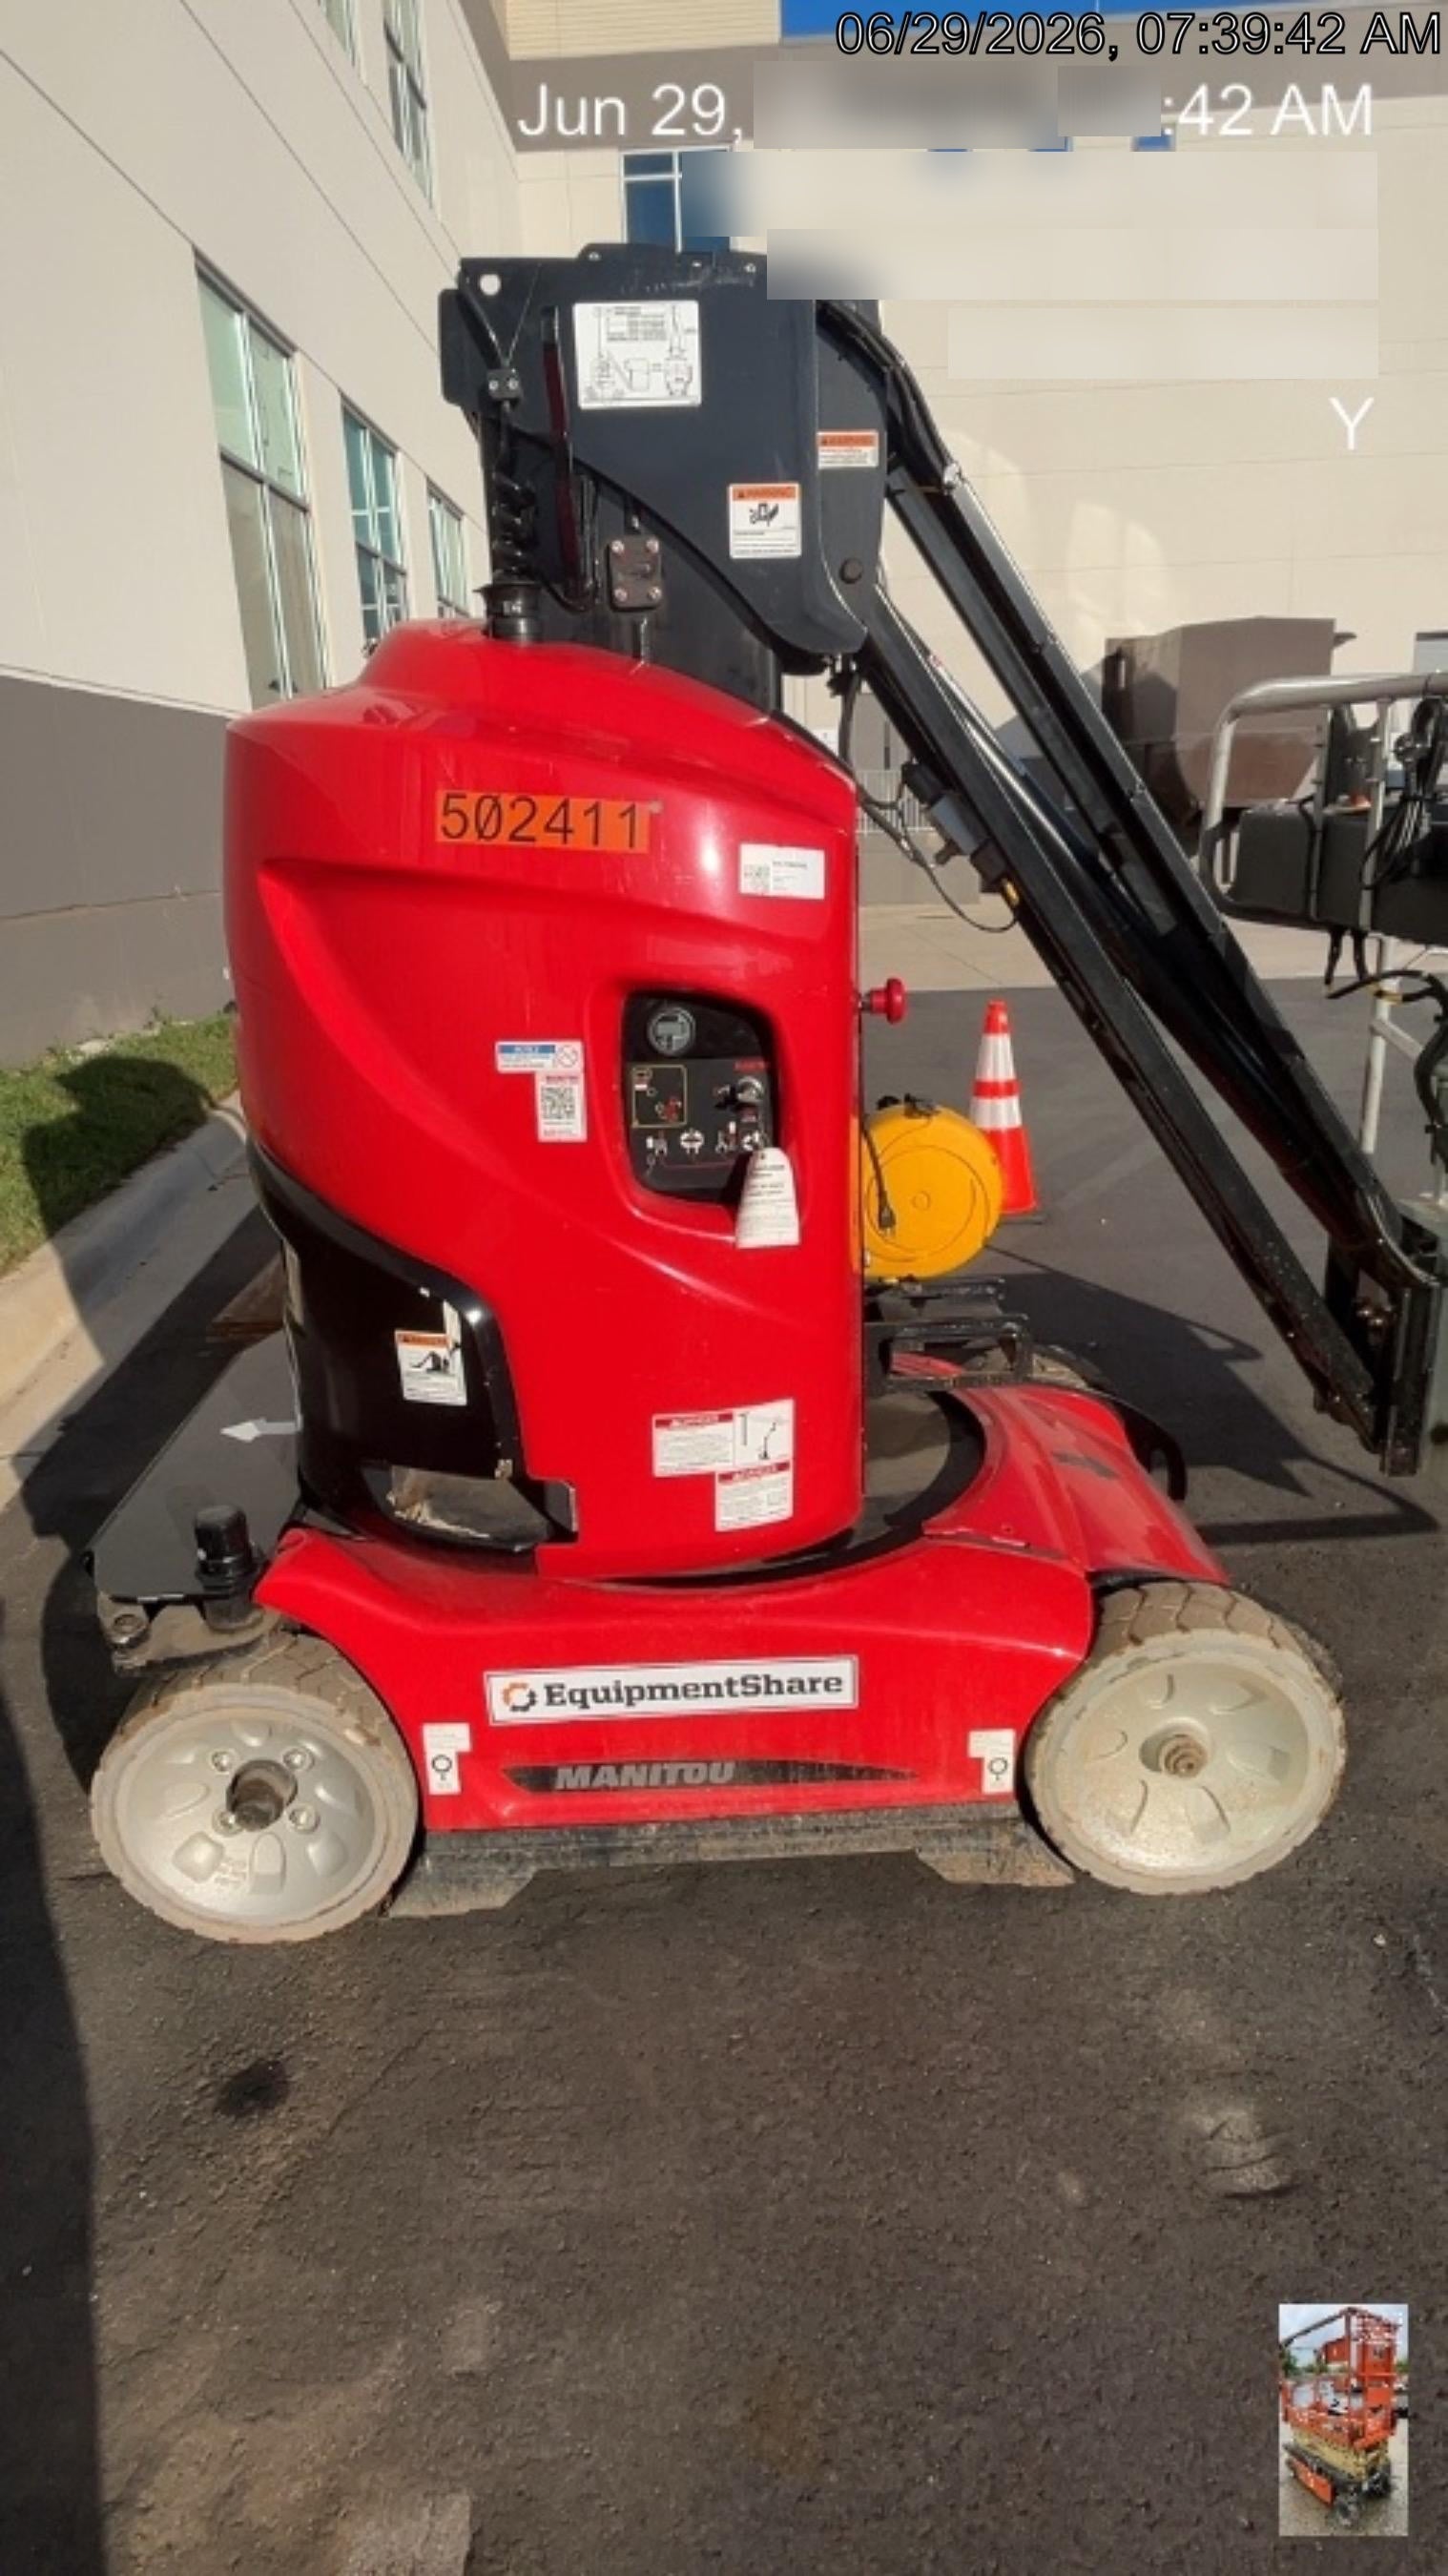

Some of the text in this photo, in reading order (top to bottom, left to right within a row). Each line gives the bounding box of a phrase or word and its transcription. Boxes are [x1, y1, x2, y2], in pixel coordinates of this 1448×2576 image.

[440, 793, 640, 849] 502411
[545, 1673, 842, 1709] EquipmentShare
[555, 1763, 735, 1790] MANITOU
